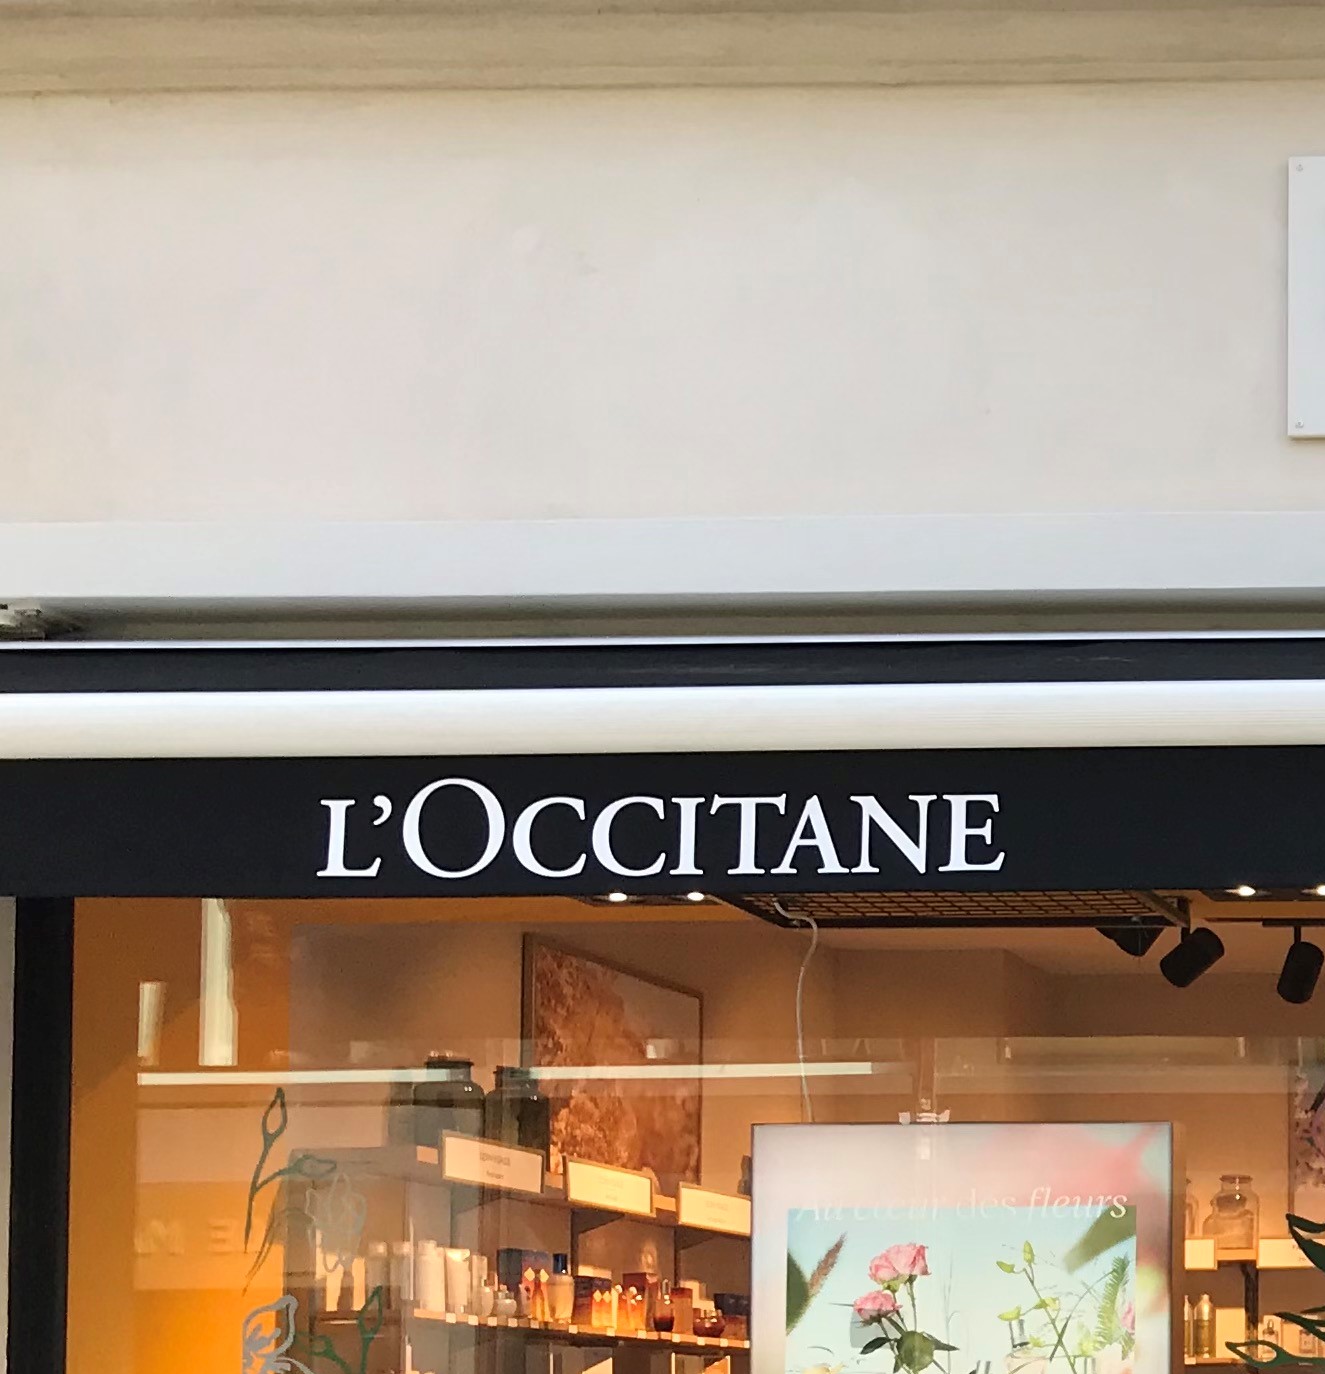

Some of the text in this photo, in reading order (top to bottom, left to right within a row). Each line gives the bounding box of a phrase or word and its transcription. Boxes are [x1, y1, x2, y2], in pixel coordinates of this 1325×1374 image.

[316, 777, 1007, 880] L'OCCITANE
[955, 1186, 1018, 1219] des
[1026, 1184, 1129, 1222] fleurs
